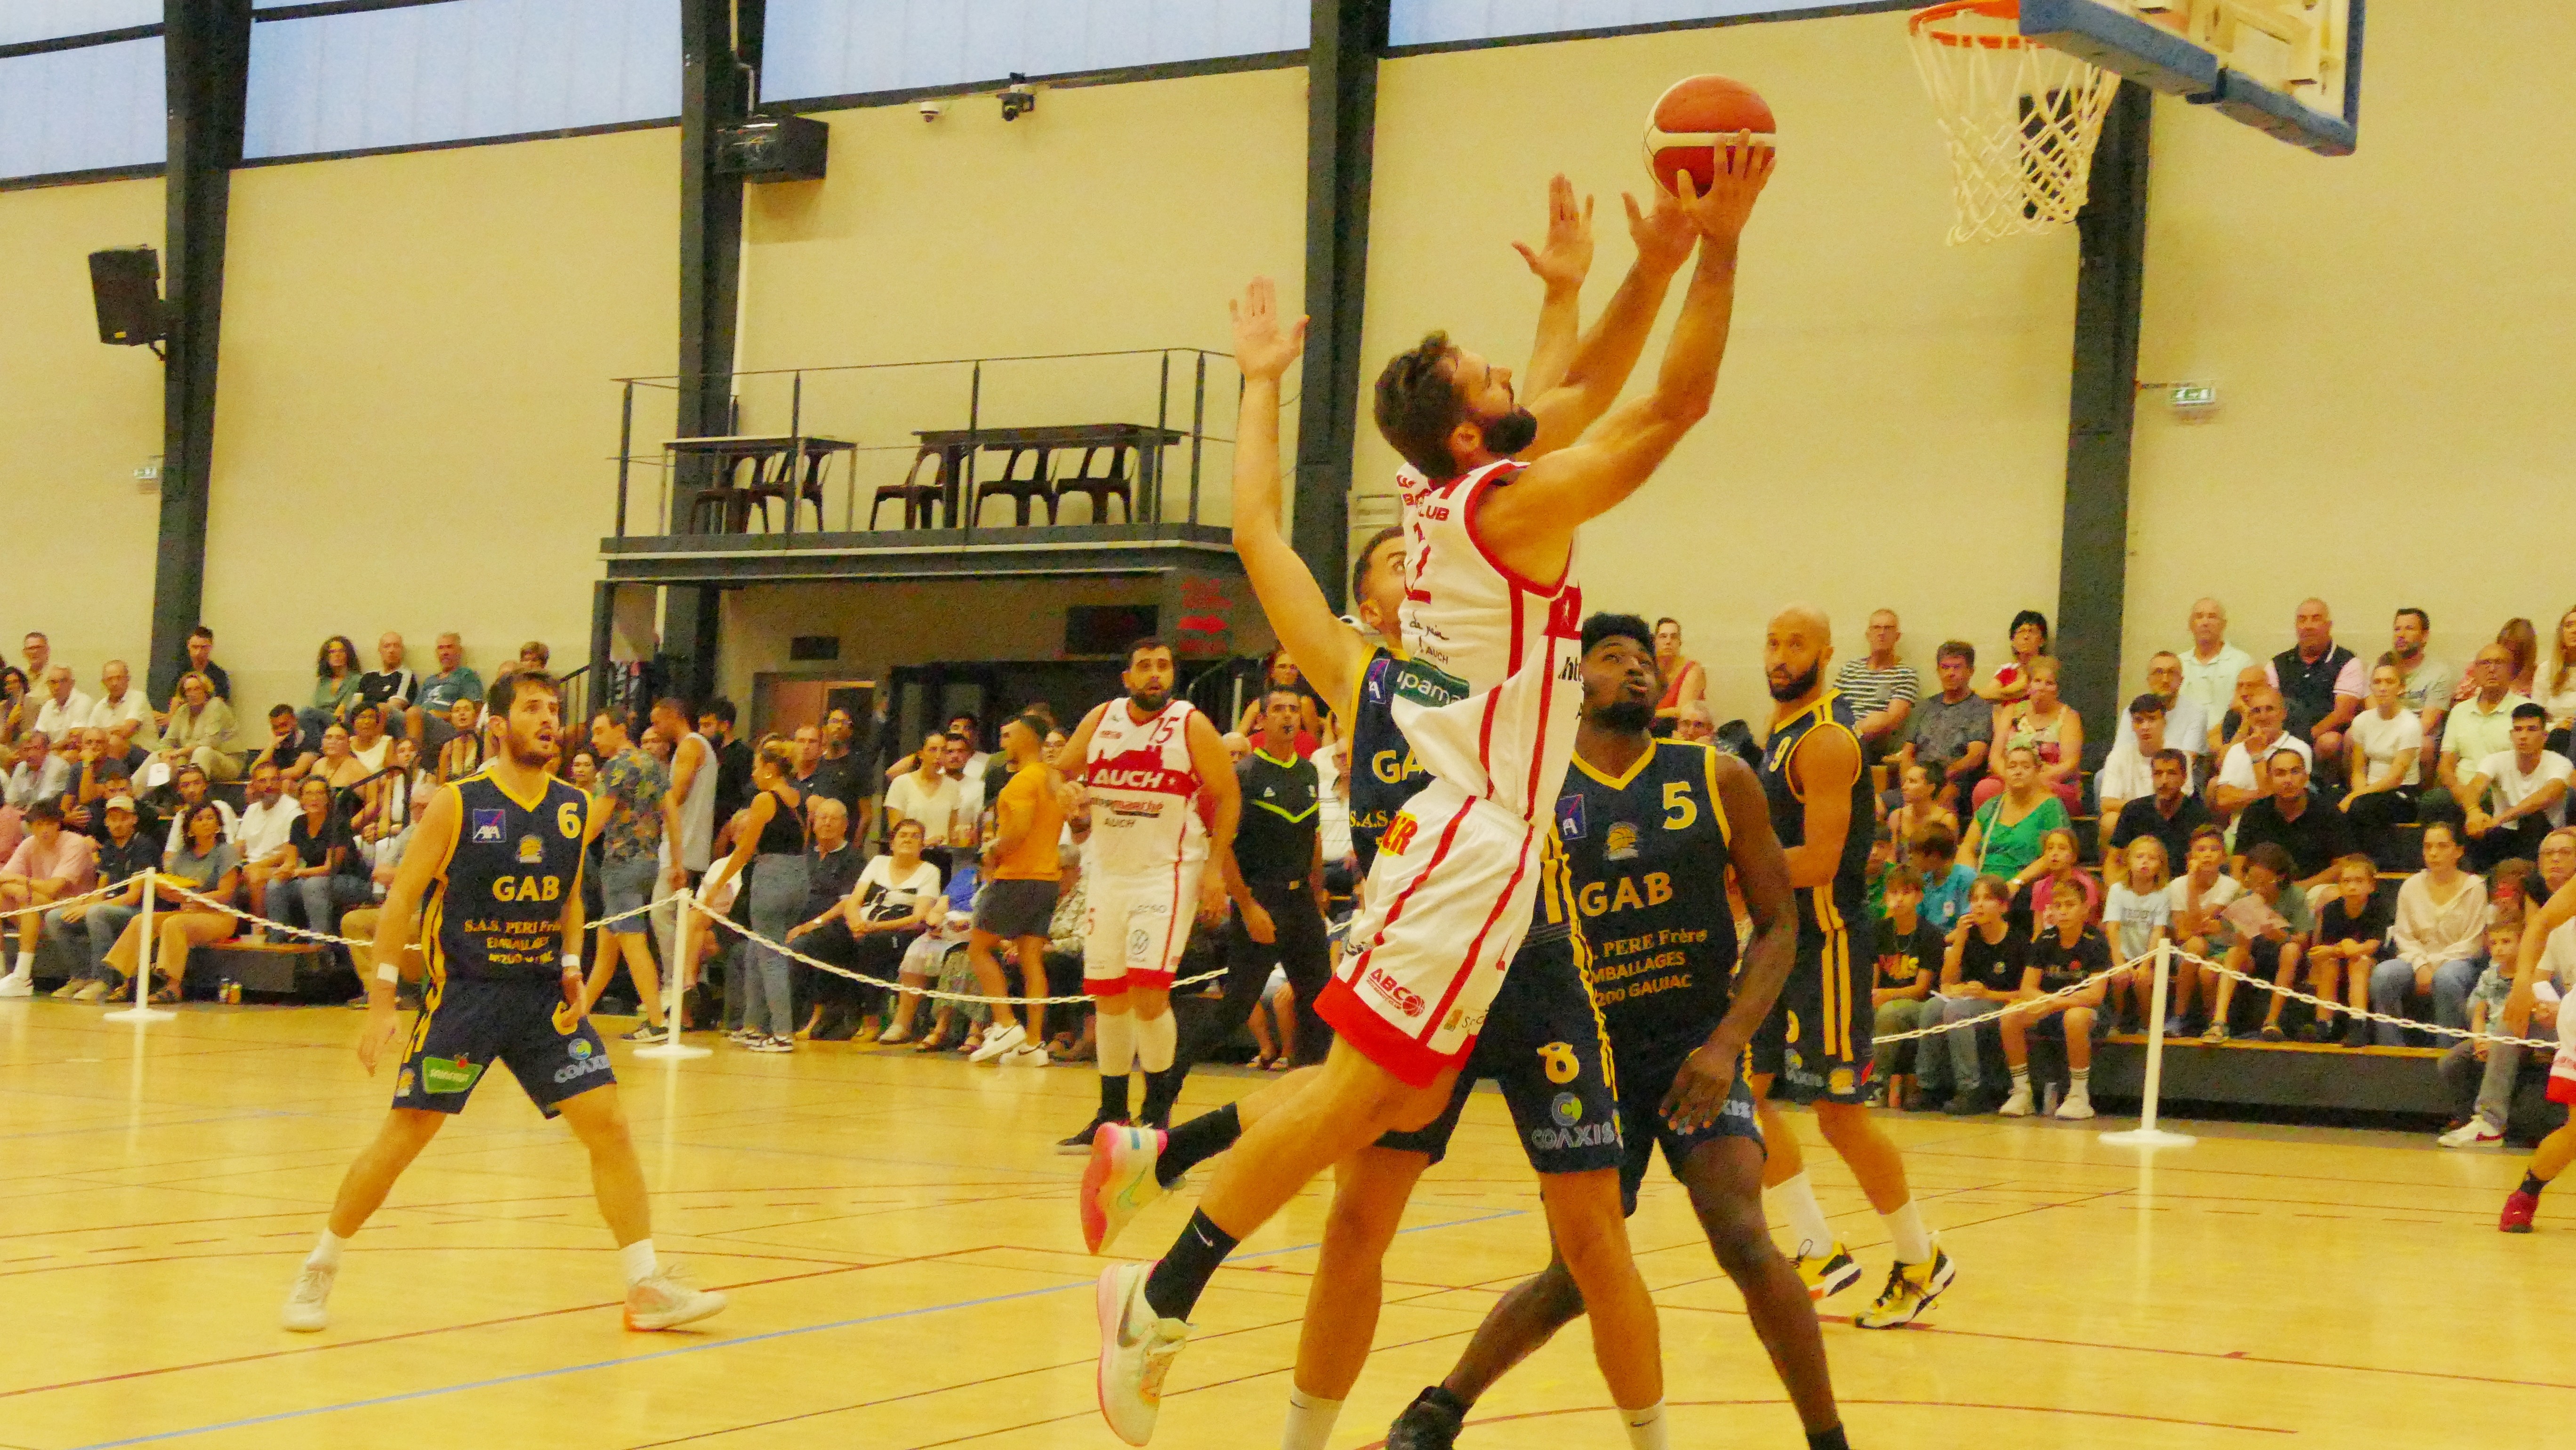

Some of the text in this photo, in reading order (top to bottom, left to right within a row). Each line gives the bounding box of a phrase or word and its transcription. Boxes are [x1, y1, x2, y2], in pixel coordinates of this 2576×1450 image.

[1417, 505, 1450, 521] LUB
[1426, 646, 1449, 665] AUCH
[1149, 716, 1180, 744] 15
[1372, 750, 1425, 784] GA
[1769, 736, 1792, 772] 9
[1092, 768, 1165, 789] AUCH
[1663, 781, 1698, 830] 5
[473, 824, 501, 839] AXA
[557, 802, 582, 839] 6
[492, 875, 560, 902] GAB
[1578, 871, 1673, 917] GAB
[1602, 934, 1655, 958] PERE
[1592, 951, 1686, 979] MBALLAGES
[1594, 989, 1626, 1007] 200
[1531, 1121, 1615, 1150] COAXIS
